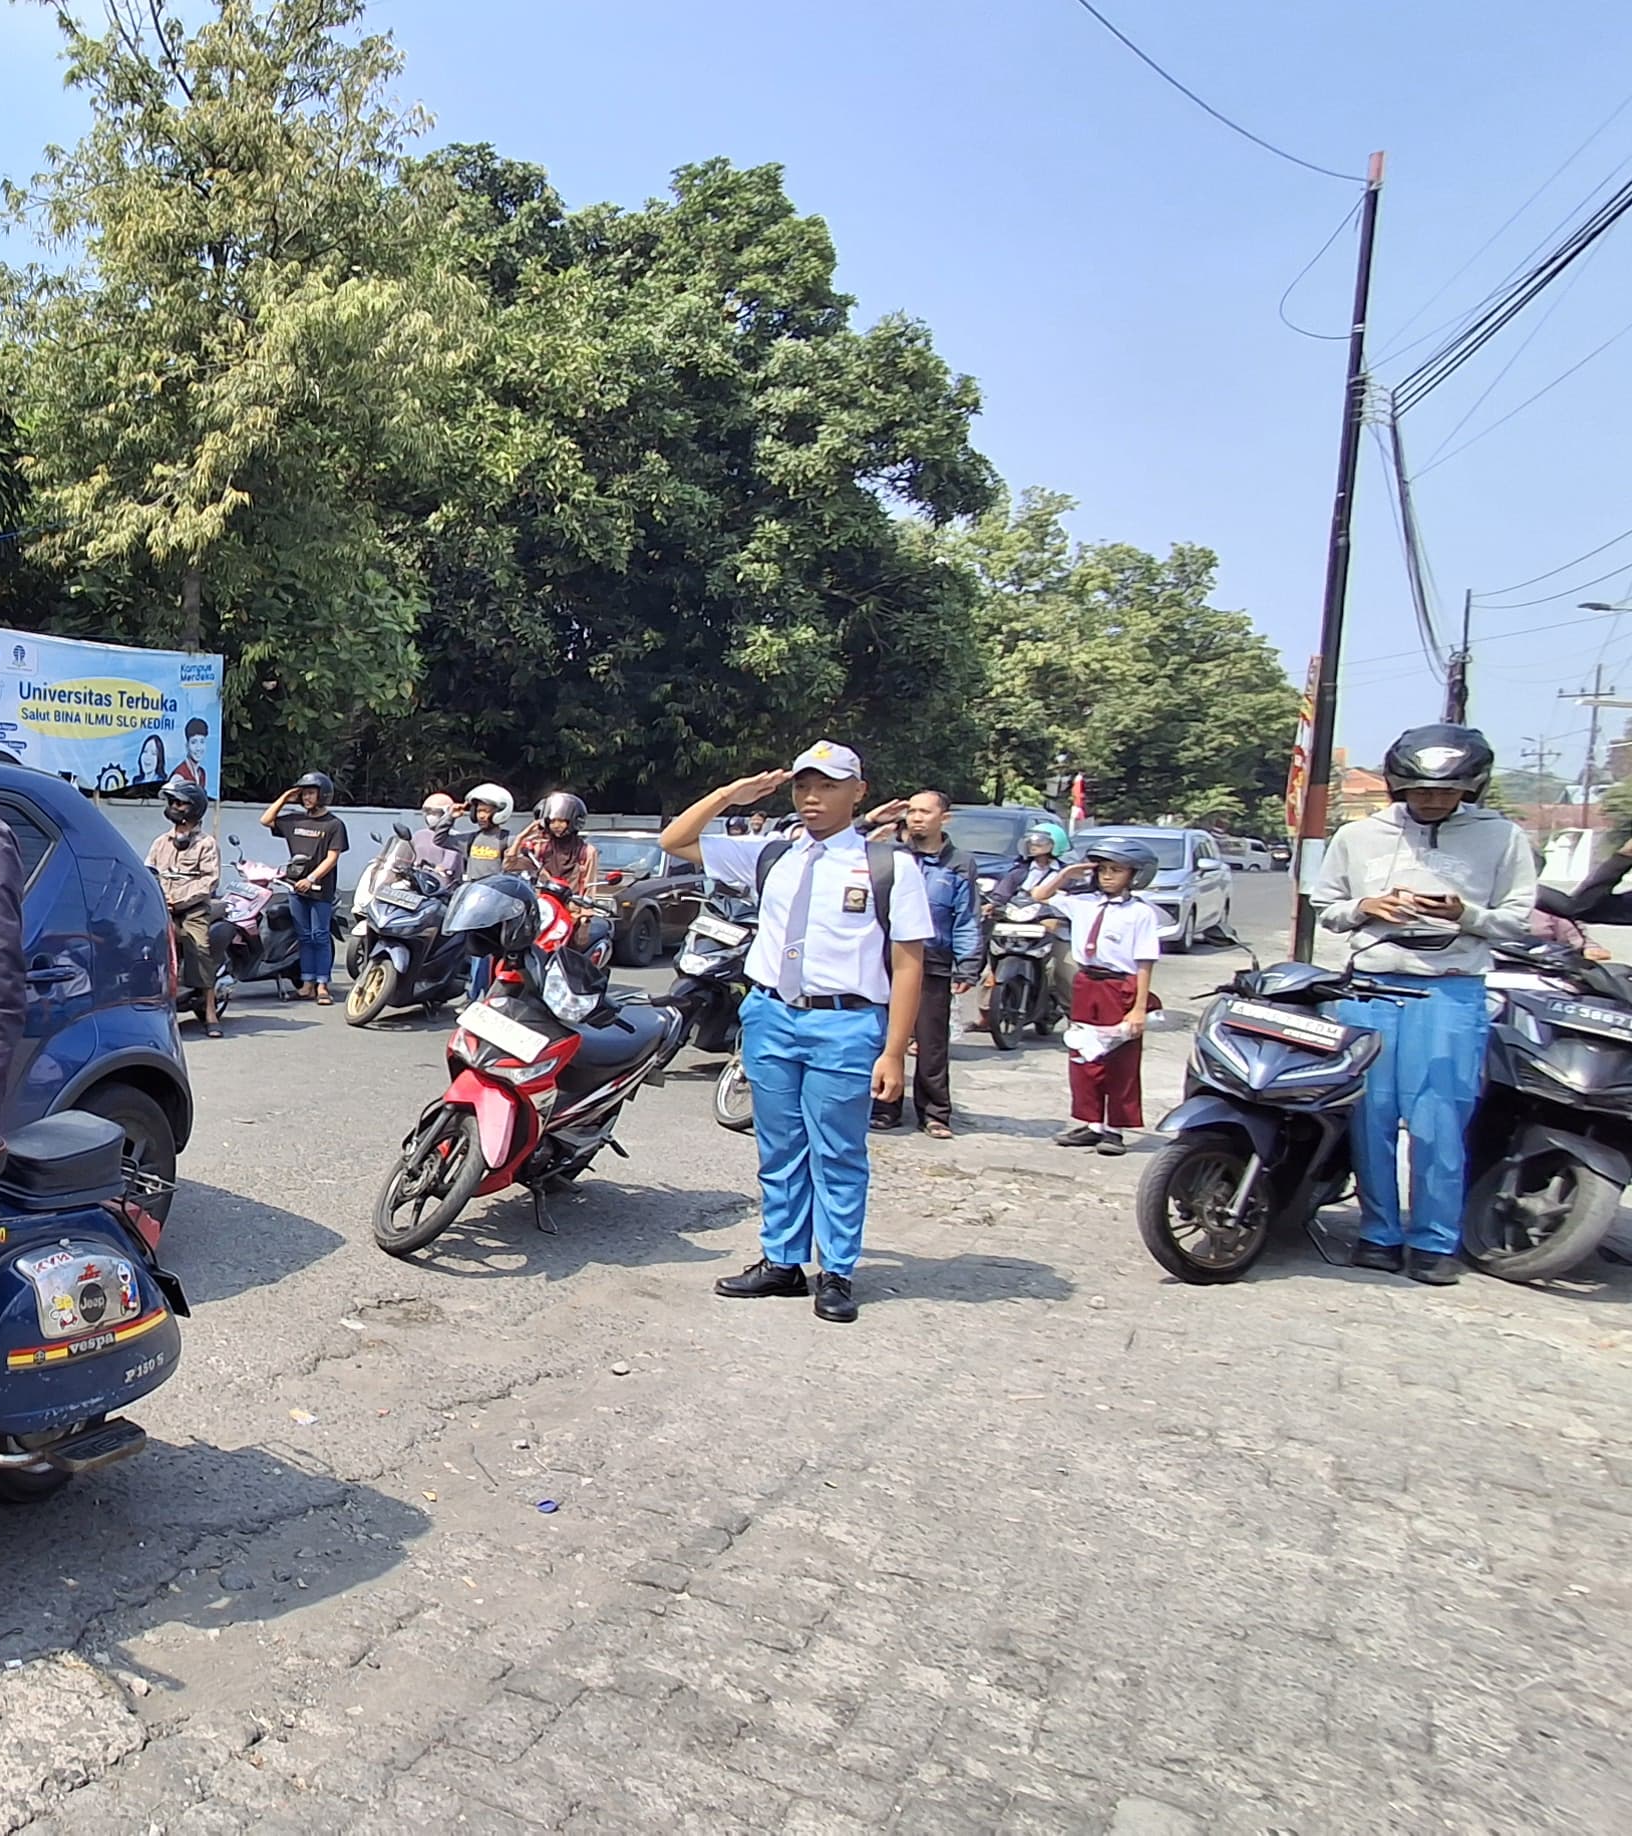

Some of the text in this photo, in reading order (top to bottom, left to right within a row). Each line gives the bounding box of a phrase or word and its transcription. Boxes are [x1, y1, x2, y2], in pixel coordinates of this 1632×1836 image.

[180, 663, 212, 675] Kampus
[180, 672, 215, 682] Merdeka
[19, 680, 177, 713] Universitas Terbuka
[20, 707, 175, 731] Salut BINA ILMU SLG KEDIRI
[80, 1295, 105, 1311] Jeep
[69, 1332, 115, 1354] vespa
